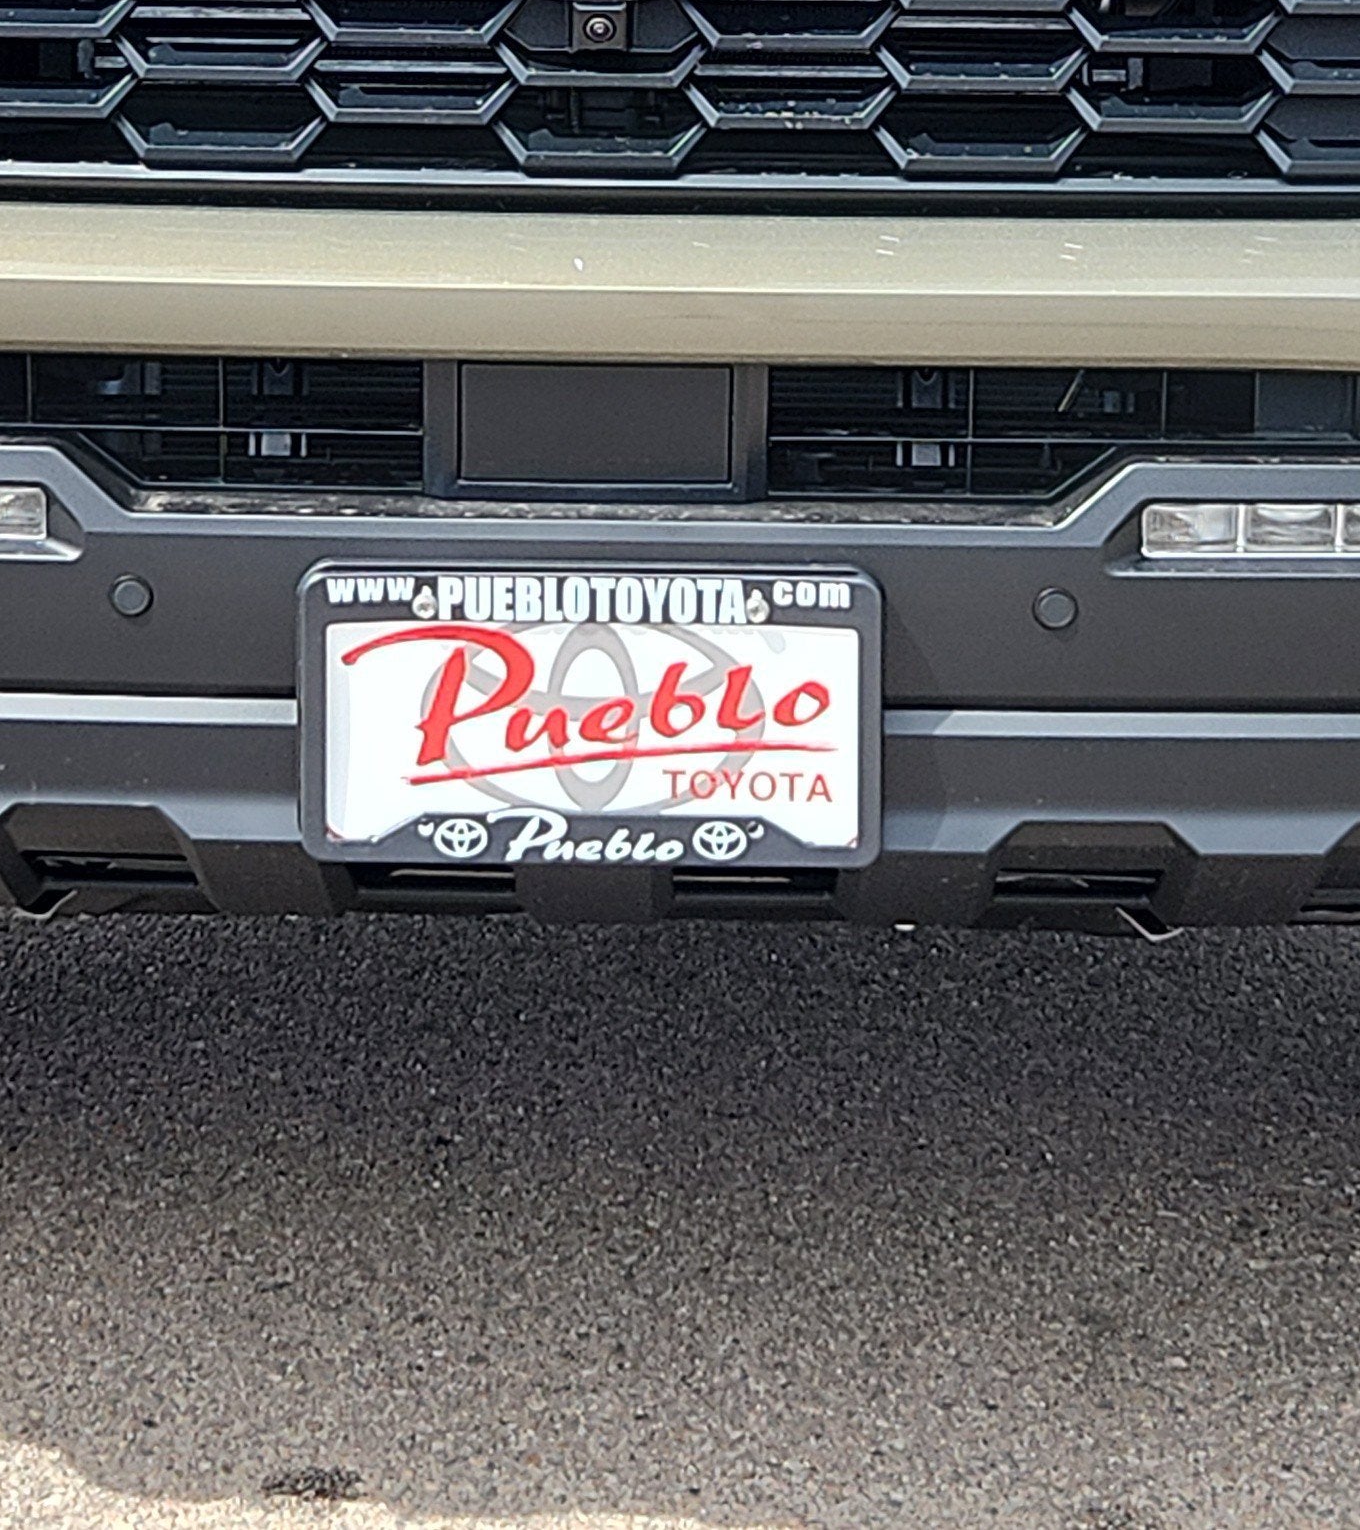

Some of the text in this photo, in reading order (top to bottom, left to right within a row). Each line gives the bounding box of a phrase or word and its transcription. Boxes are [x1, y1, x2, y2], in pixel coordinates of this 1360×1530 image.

[326, 575, 851, 624] www PUEBLOTOYOTA com
[341, 625, 831, 766] Pueblo
[662, 769, 833, 803] TOYOTA
[486, 807, 684, 862] Pueblo
